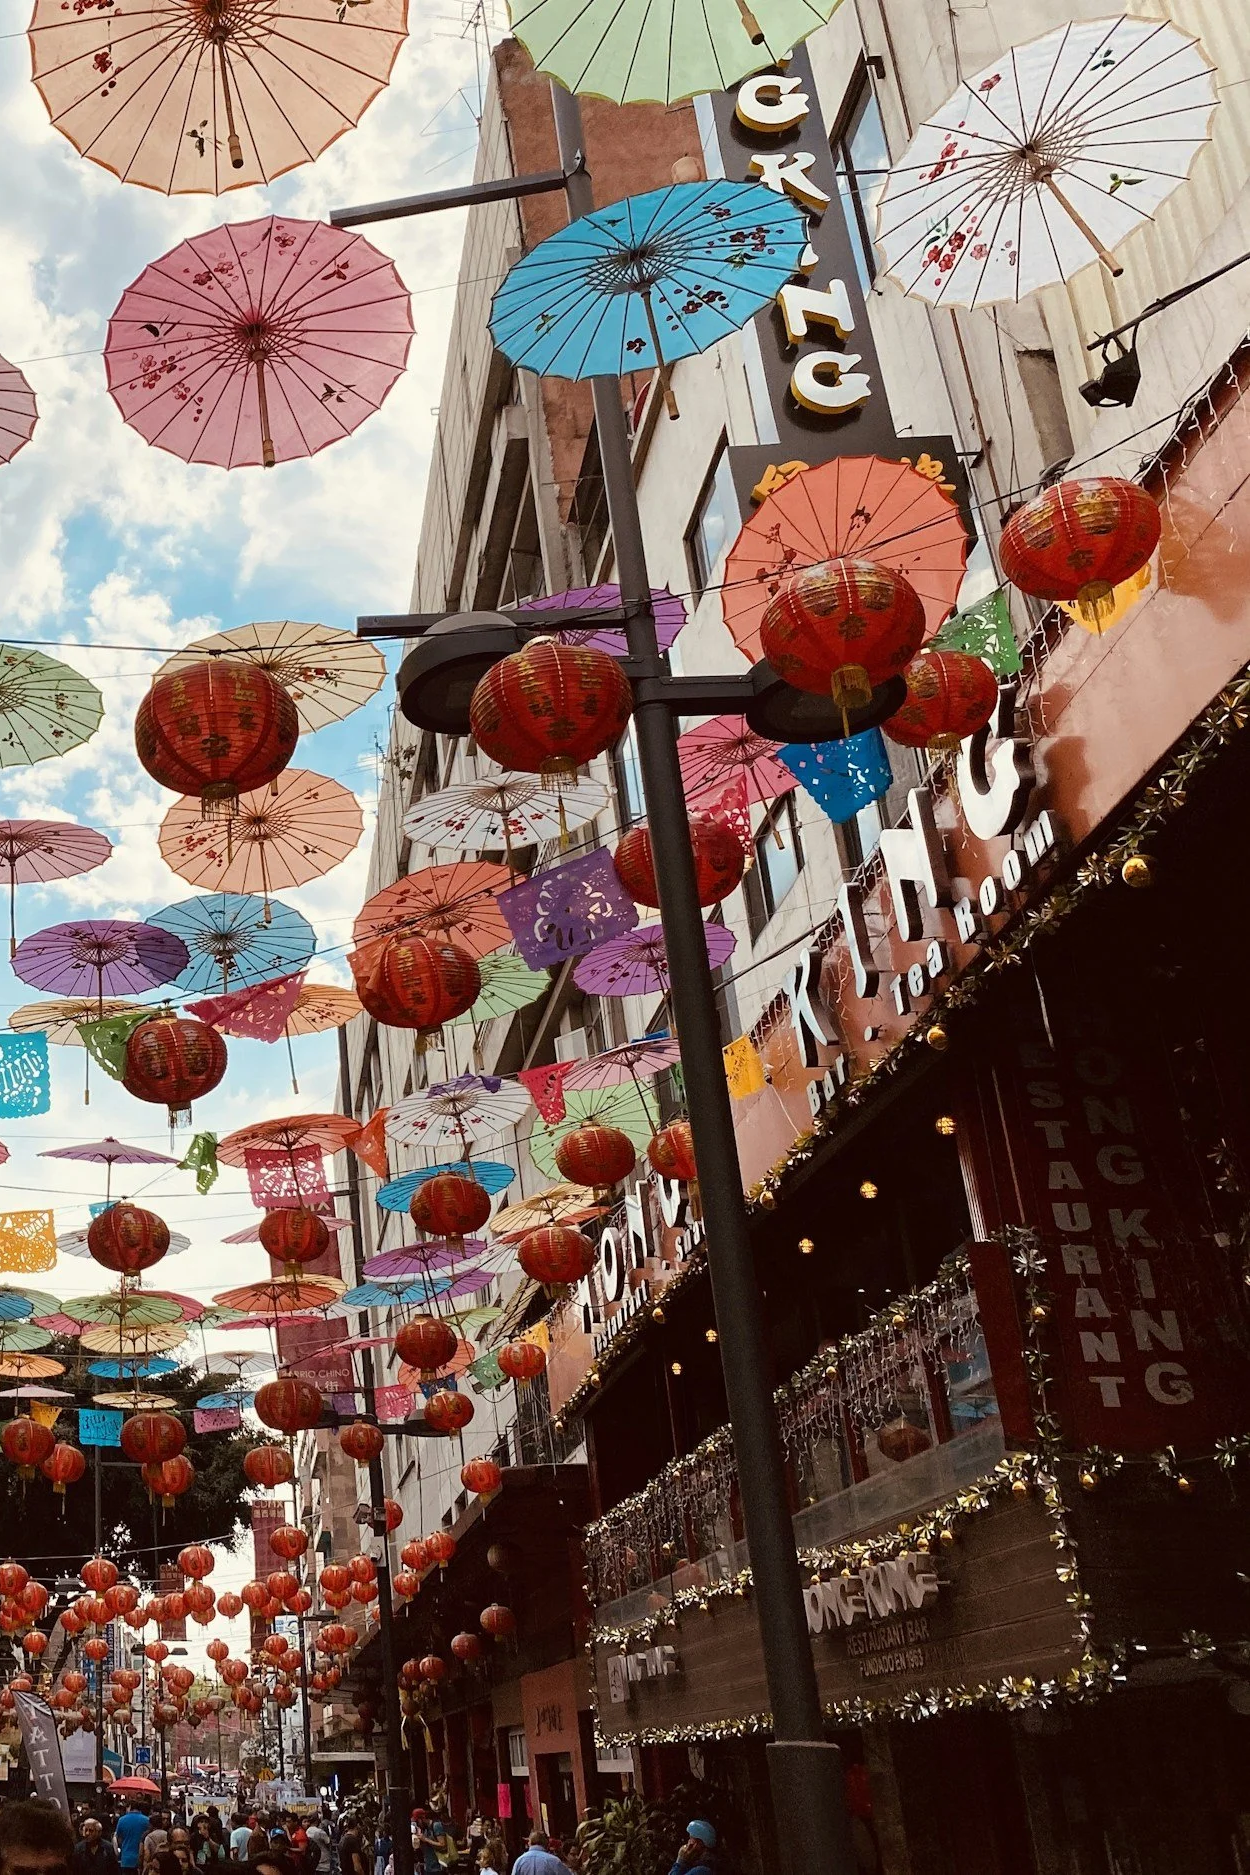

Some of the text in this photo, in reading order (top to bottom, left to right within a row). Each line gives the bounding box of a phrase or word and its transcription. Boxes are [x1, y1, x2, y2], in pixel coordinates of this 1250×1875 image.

[750, 151, 871, 414] KNG
[890, 811, 1055, 1016] Tea Room
[806, 1053, 845, 1117] Bar
[1008, 1003, 1126, 1408] ESTAURANT
[1068, 1006, 1195, 1405] ONG KING
[318, 1368, 350, 1379] CHINO
[906, 1617, 930, 1643] BAR
